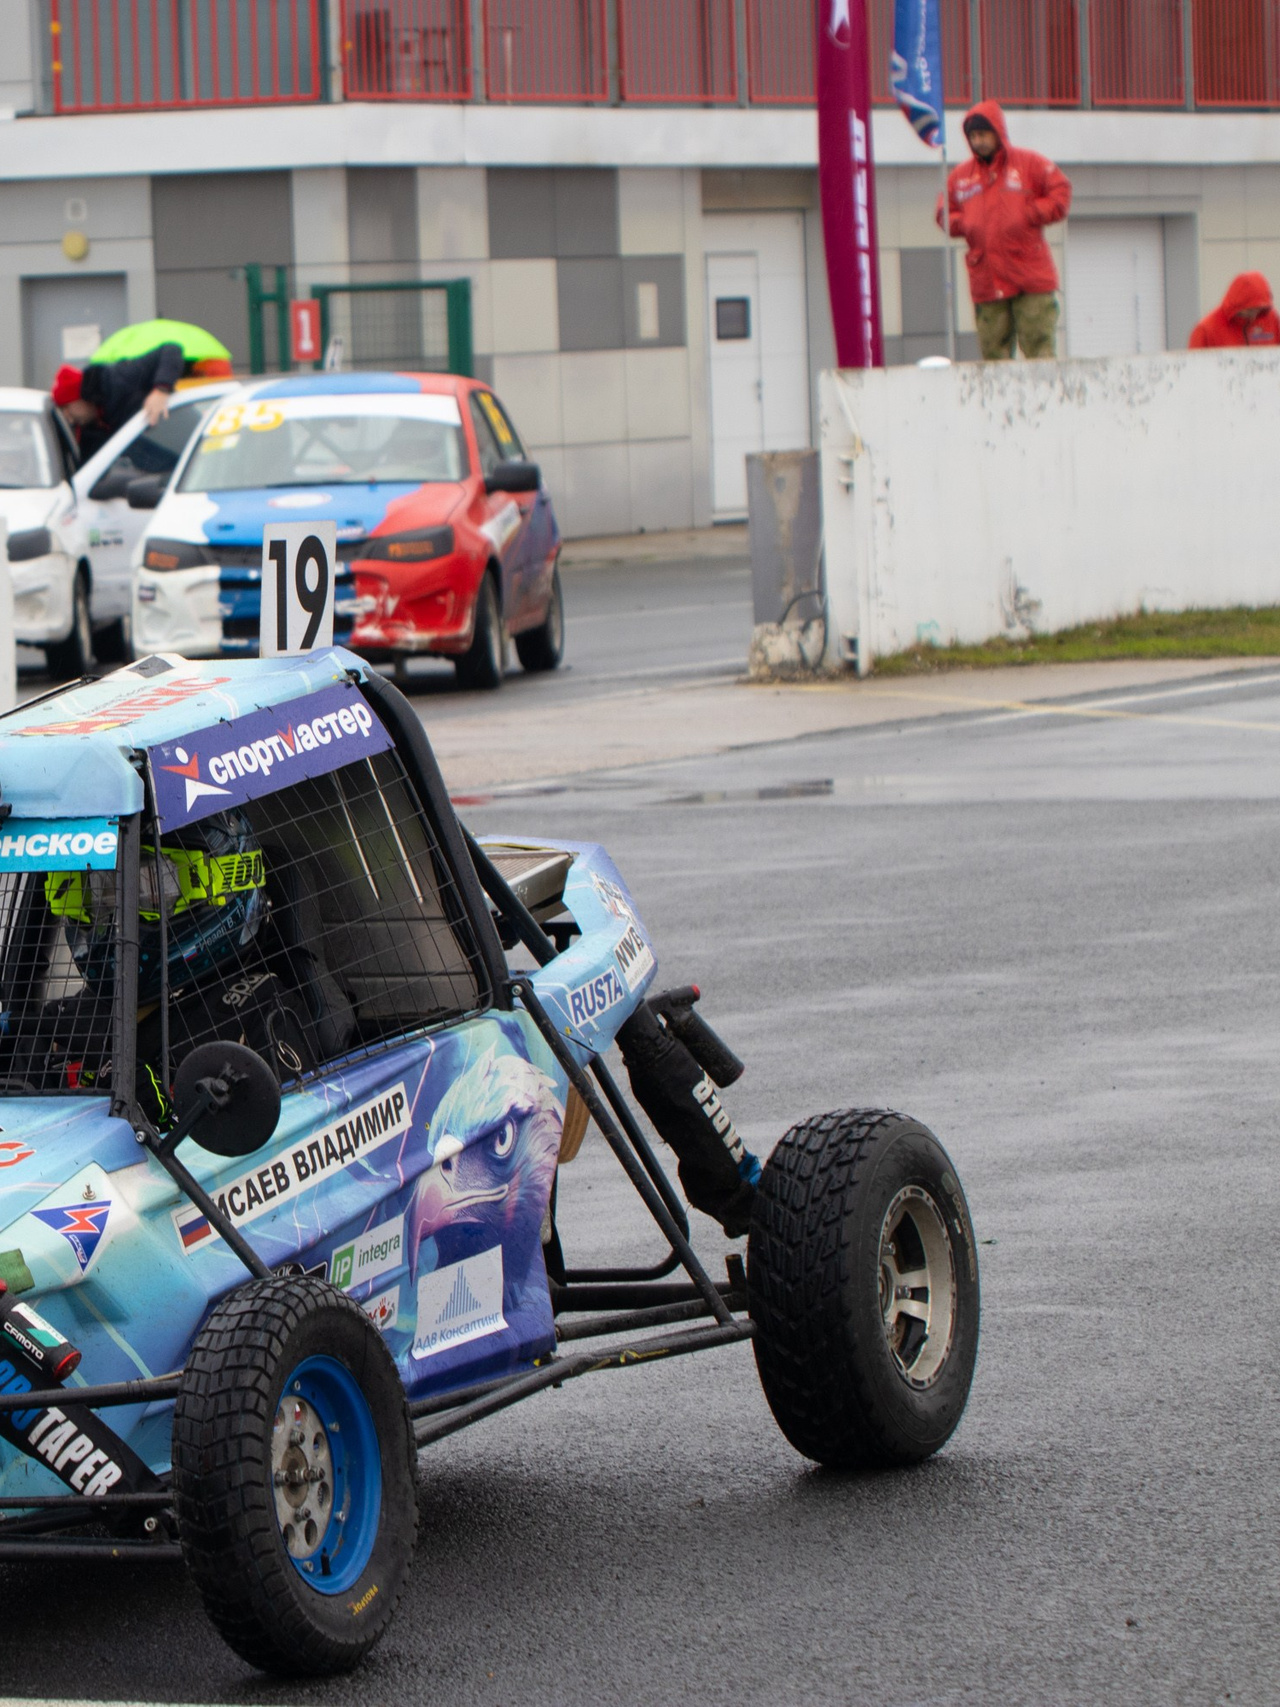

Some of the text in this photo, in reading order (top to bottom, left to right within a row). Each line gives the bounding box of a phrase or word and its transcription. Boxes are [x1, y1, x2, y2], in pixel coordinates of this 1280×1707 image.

[207, 401, 286, 437] 85
[269, 535, 329, 651] 19
[570, 970, 624, 1025] RUSTA
[291, 1091, 405, 1184] ВЛАДИМИР
[333, 1233, 401, 1285] IP integra
[3, 1320, 44, 1360] CFMOTO
[414, 1311, 501, 1352] АДВ Консалтинг
